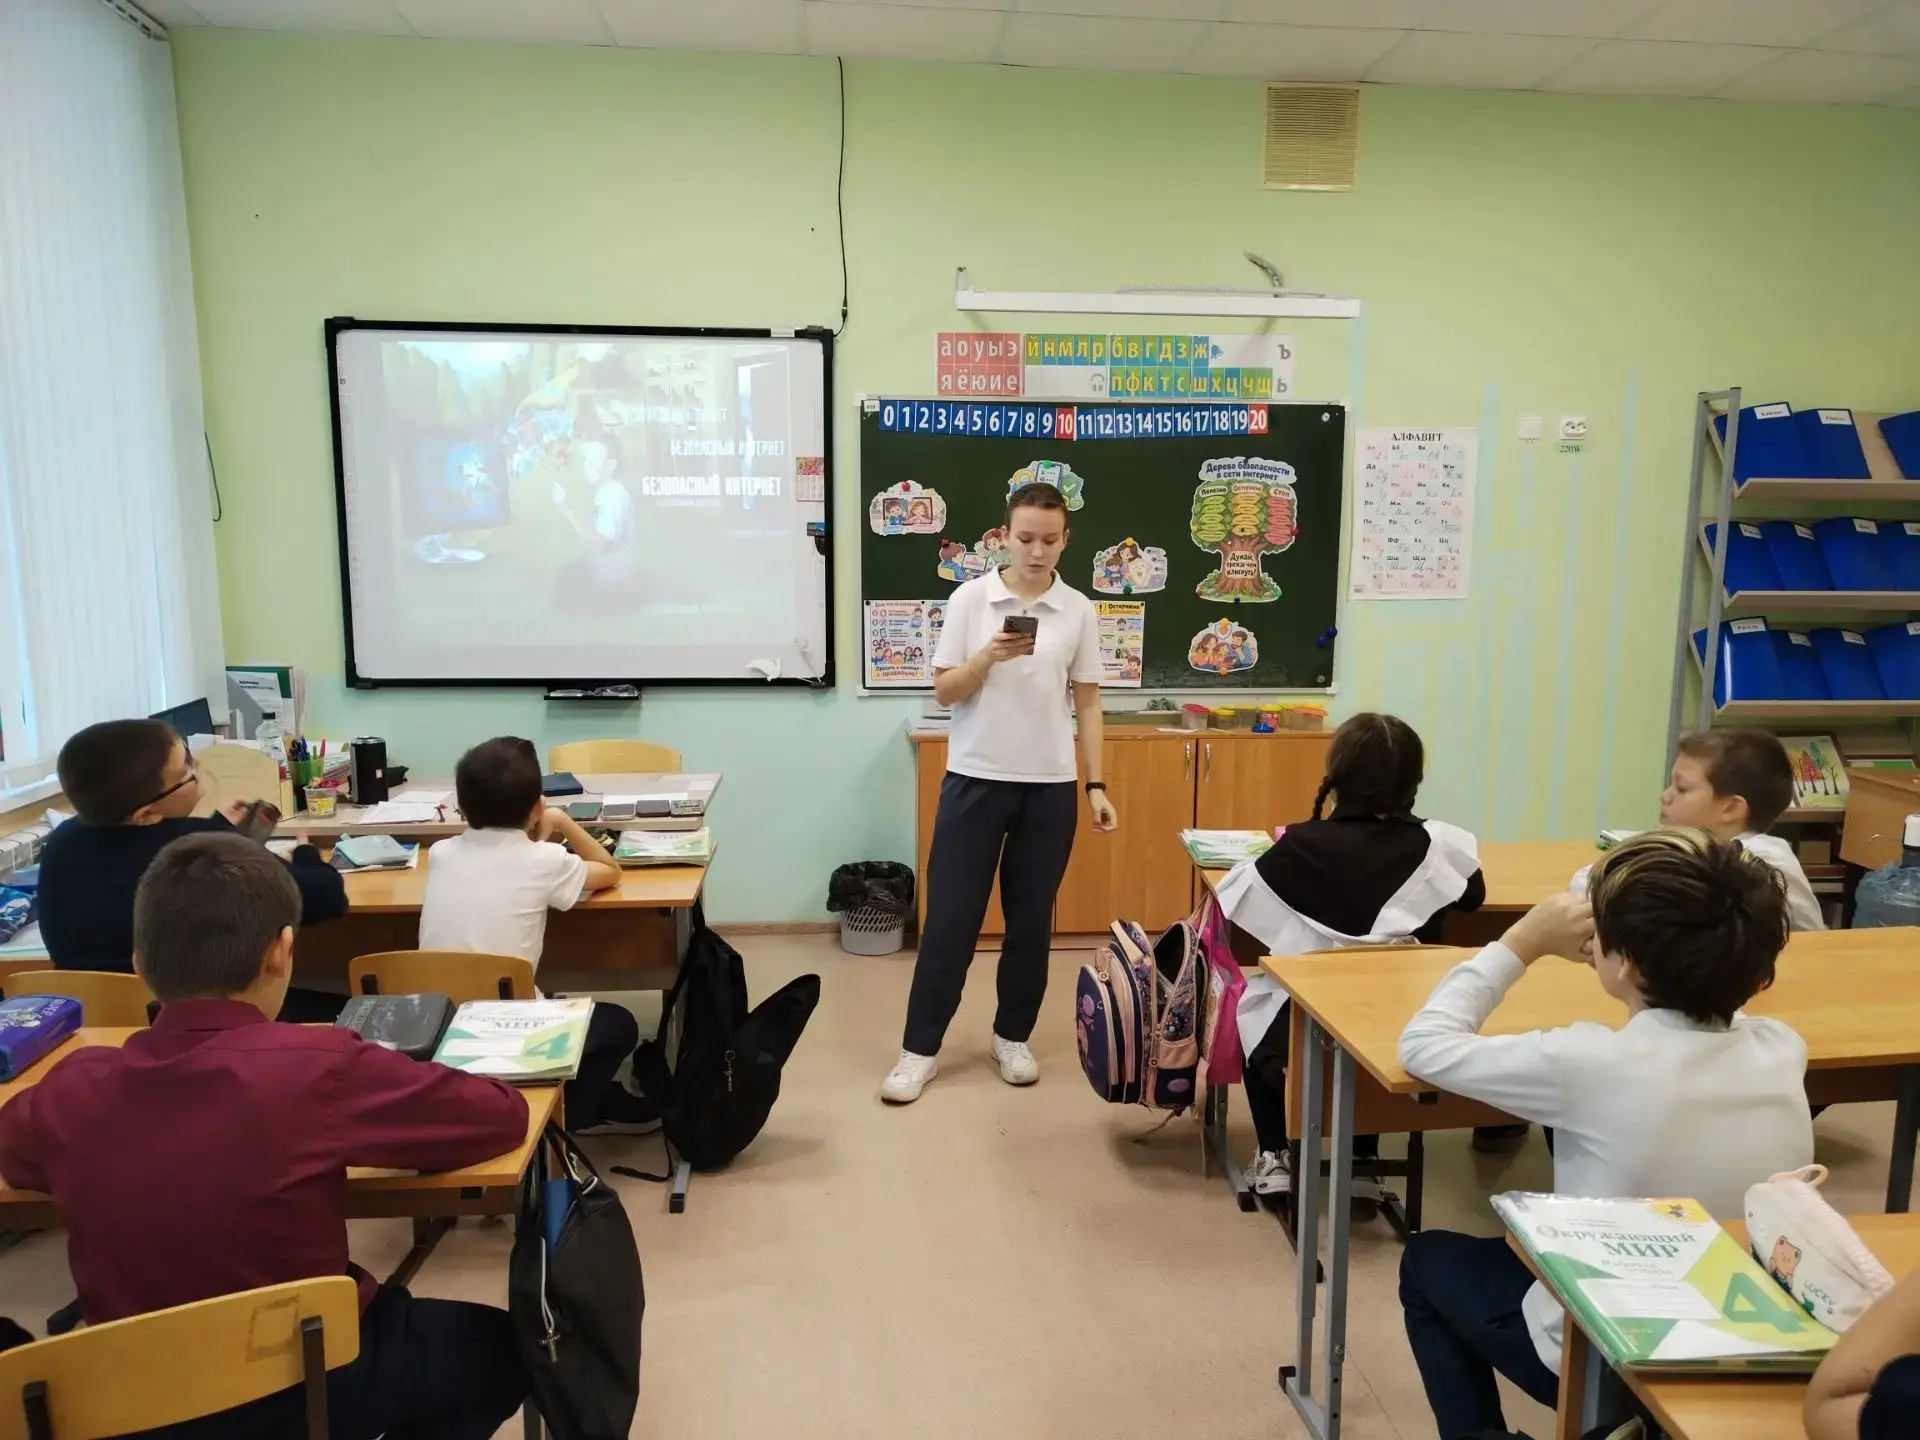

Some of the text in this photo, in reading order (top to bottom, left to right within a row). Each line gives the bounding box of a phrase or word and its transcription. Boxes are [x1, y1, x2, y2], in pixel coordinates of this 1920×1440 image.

[884, 406, 1267, 435] 0 1 2 3 4 5 6 7 8 9 10 11 12 13 14 15 16 17 18 19 20
[1391, 432, 1443, 441] АЛФАВИТ
[1206, 461, 1290, 476] Дерево безопасности
[1243, 471, 1278, 481] Интернет
[642, 472, 782, 496] БЕЗОПАСНЫЙ ИНТЕРНЕТ
[1201, 488, 1227, 496] Полезно
[1273, 488, 1290, 497] Стоп
[523, 1031, 571, 1060] 4
[1536, 1224, 1697, 1243] Окружающий
[1600, 1241, 1680, 1258] МИР
[1721, 1272, 1810, 1334] 4
